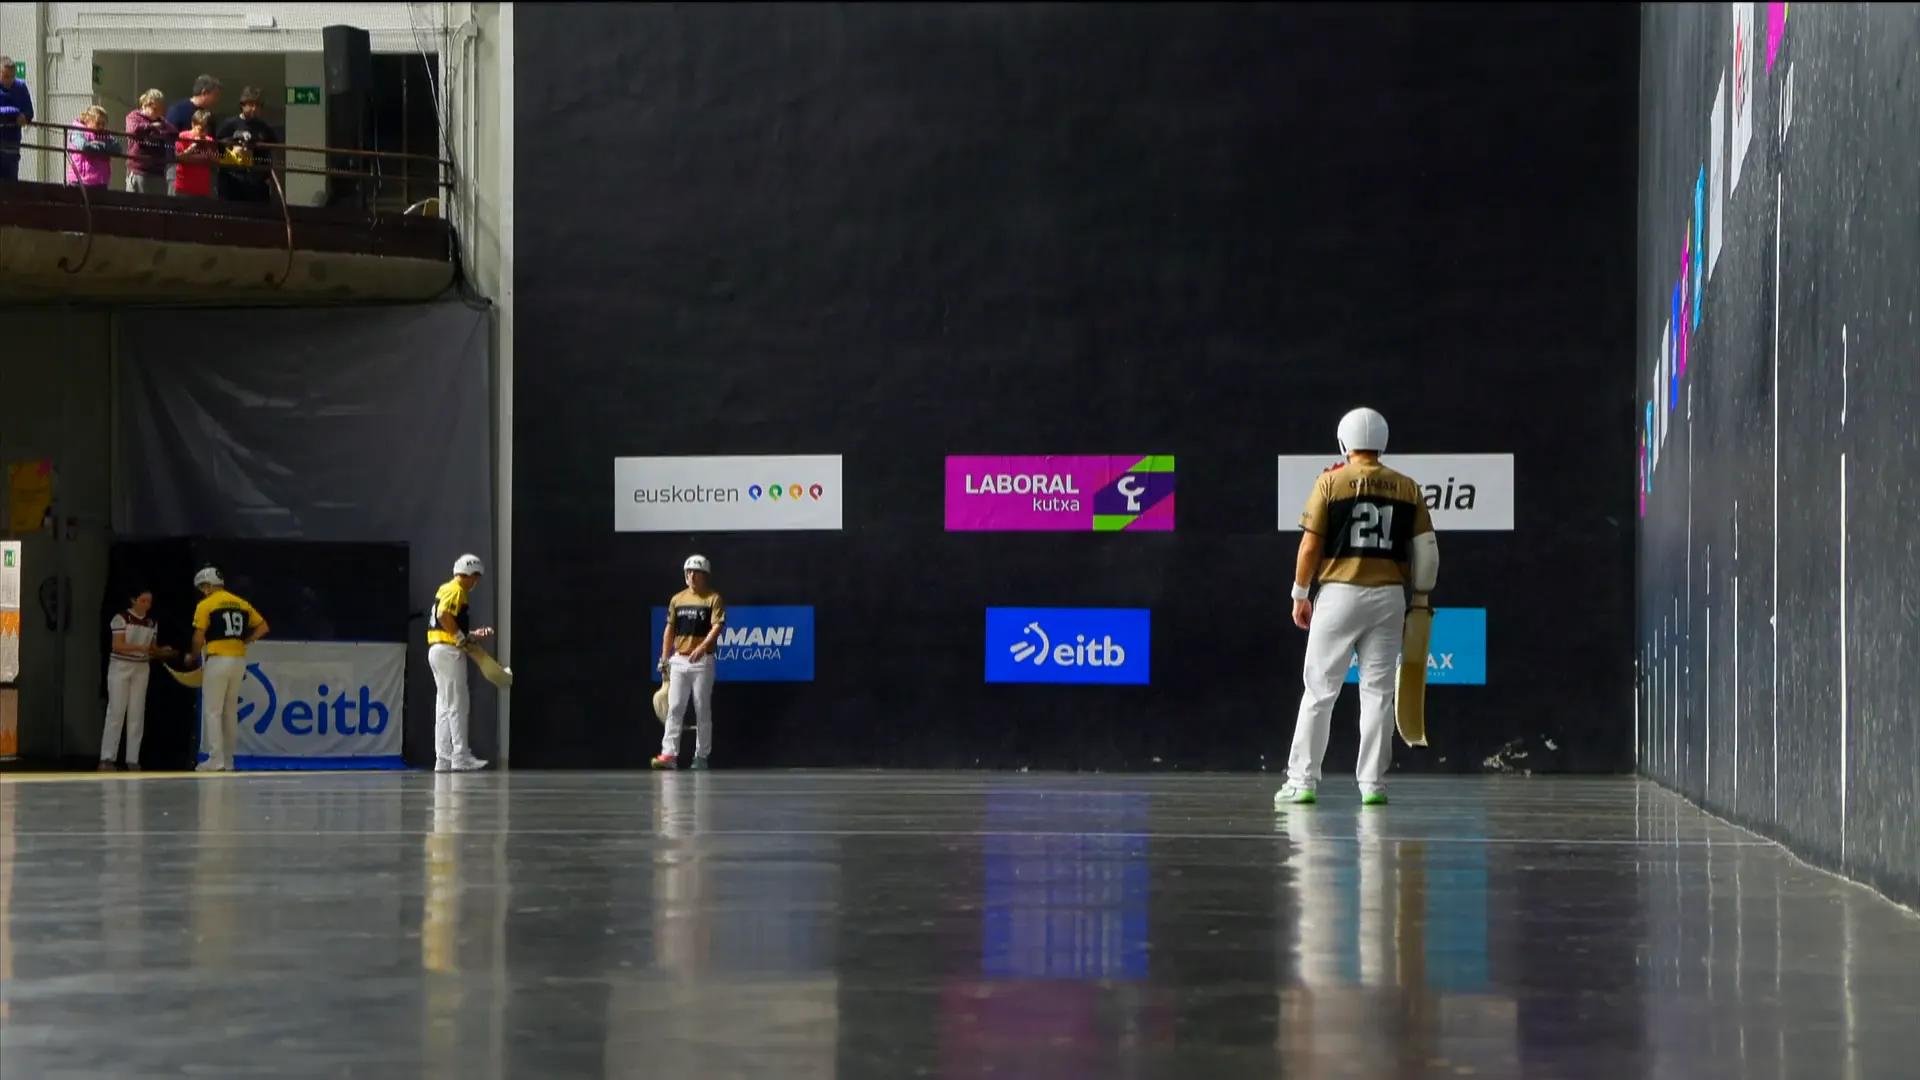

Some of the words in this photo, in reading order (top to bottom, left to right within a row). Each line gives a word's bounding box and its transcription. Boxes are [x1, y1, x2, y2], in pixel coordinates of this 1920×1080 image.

[634, 485, 739, 503] euskotren
[965, 474, 1080, 494] LABORAL
[1033, 497, 1080, 512] kutxa
[1350, 502, 1394, 550] 21
[222, 611, 243, 636] 19
[715, 648, 739, 660] LAI
[742, 647, 781, 660] GARA
[1053, 634, 1125, 667] eitb
[281, 684, 389, 736] eitb
